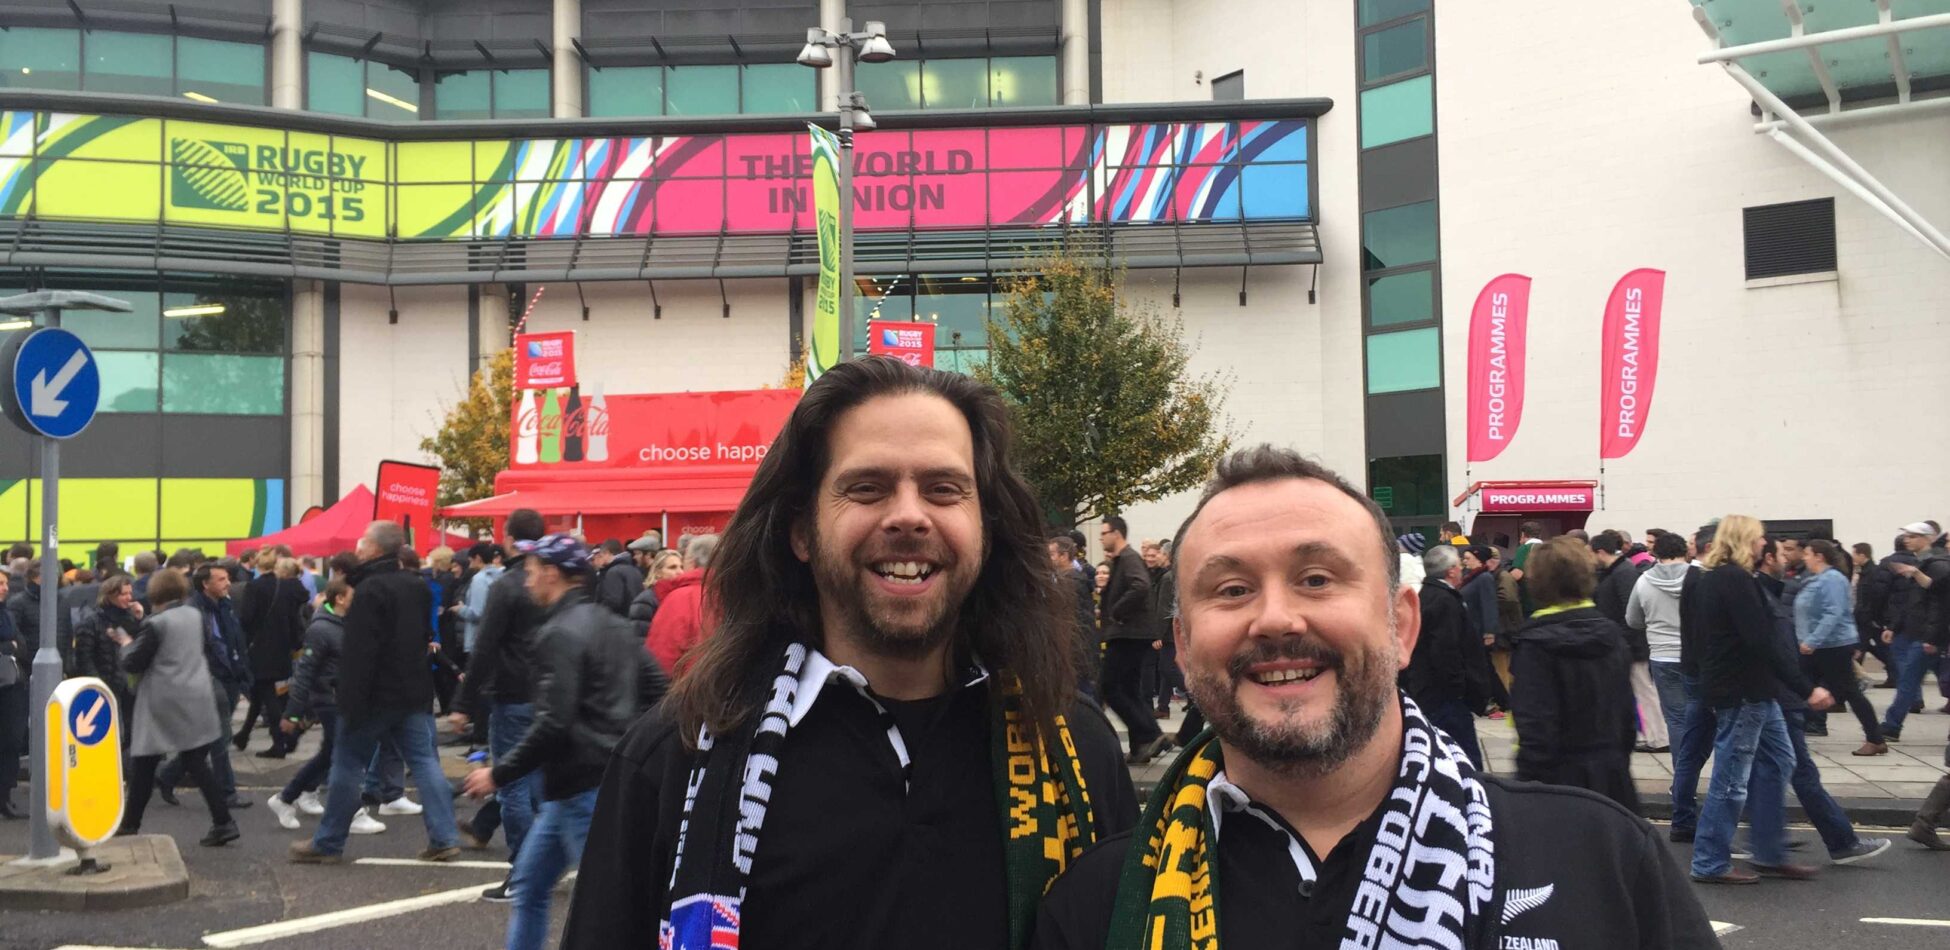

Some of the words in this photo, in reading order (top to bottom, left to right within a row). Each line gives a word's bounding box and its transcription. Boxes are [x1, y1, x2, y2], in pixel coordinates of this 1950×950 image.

[256, 144, 366, 178] RUGBY
[739, 154, 814, 180] THE
[852, 149, 974, 177] ORLD
[257, 172, 325, 191] WORLD
[332, 179, 365, 194] CUP
[769, 187, 808, 213] IN
[853, 183, 945, 212] NION
[256, 188, 365, 222] 2015
[898, 340, 923, 348] 2015
[1488, 292, 1508, 440] PROGRAMMES
[1618, 287, 1642, 438] PROGRAMMES
[639, 443, 711, 462] choose
[717, 441, 774, 462] happ
[389, 482, 426, 497] choose
[1489, 493, 1586, 505] PROGRAMMES
[1340, 728, 1431, 950] OCTOBER
[1460, 777, 1495, 916] FINAL
[1503, 935, 1560, 950] ZEALAND
